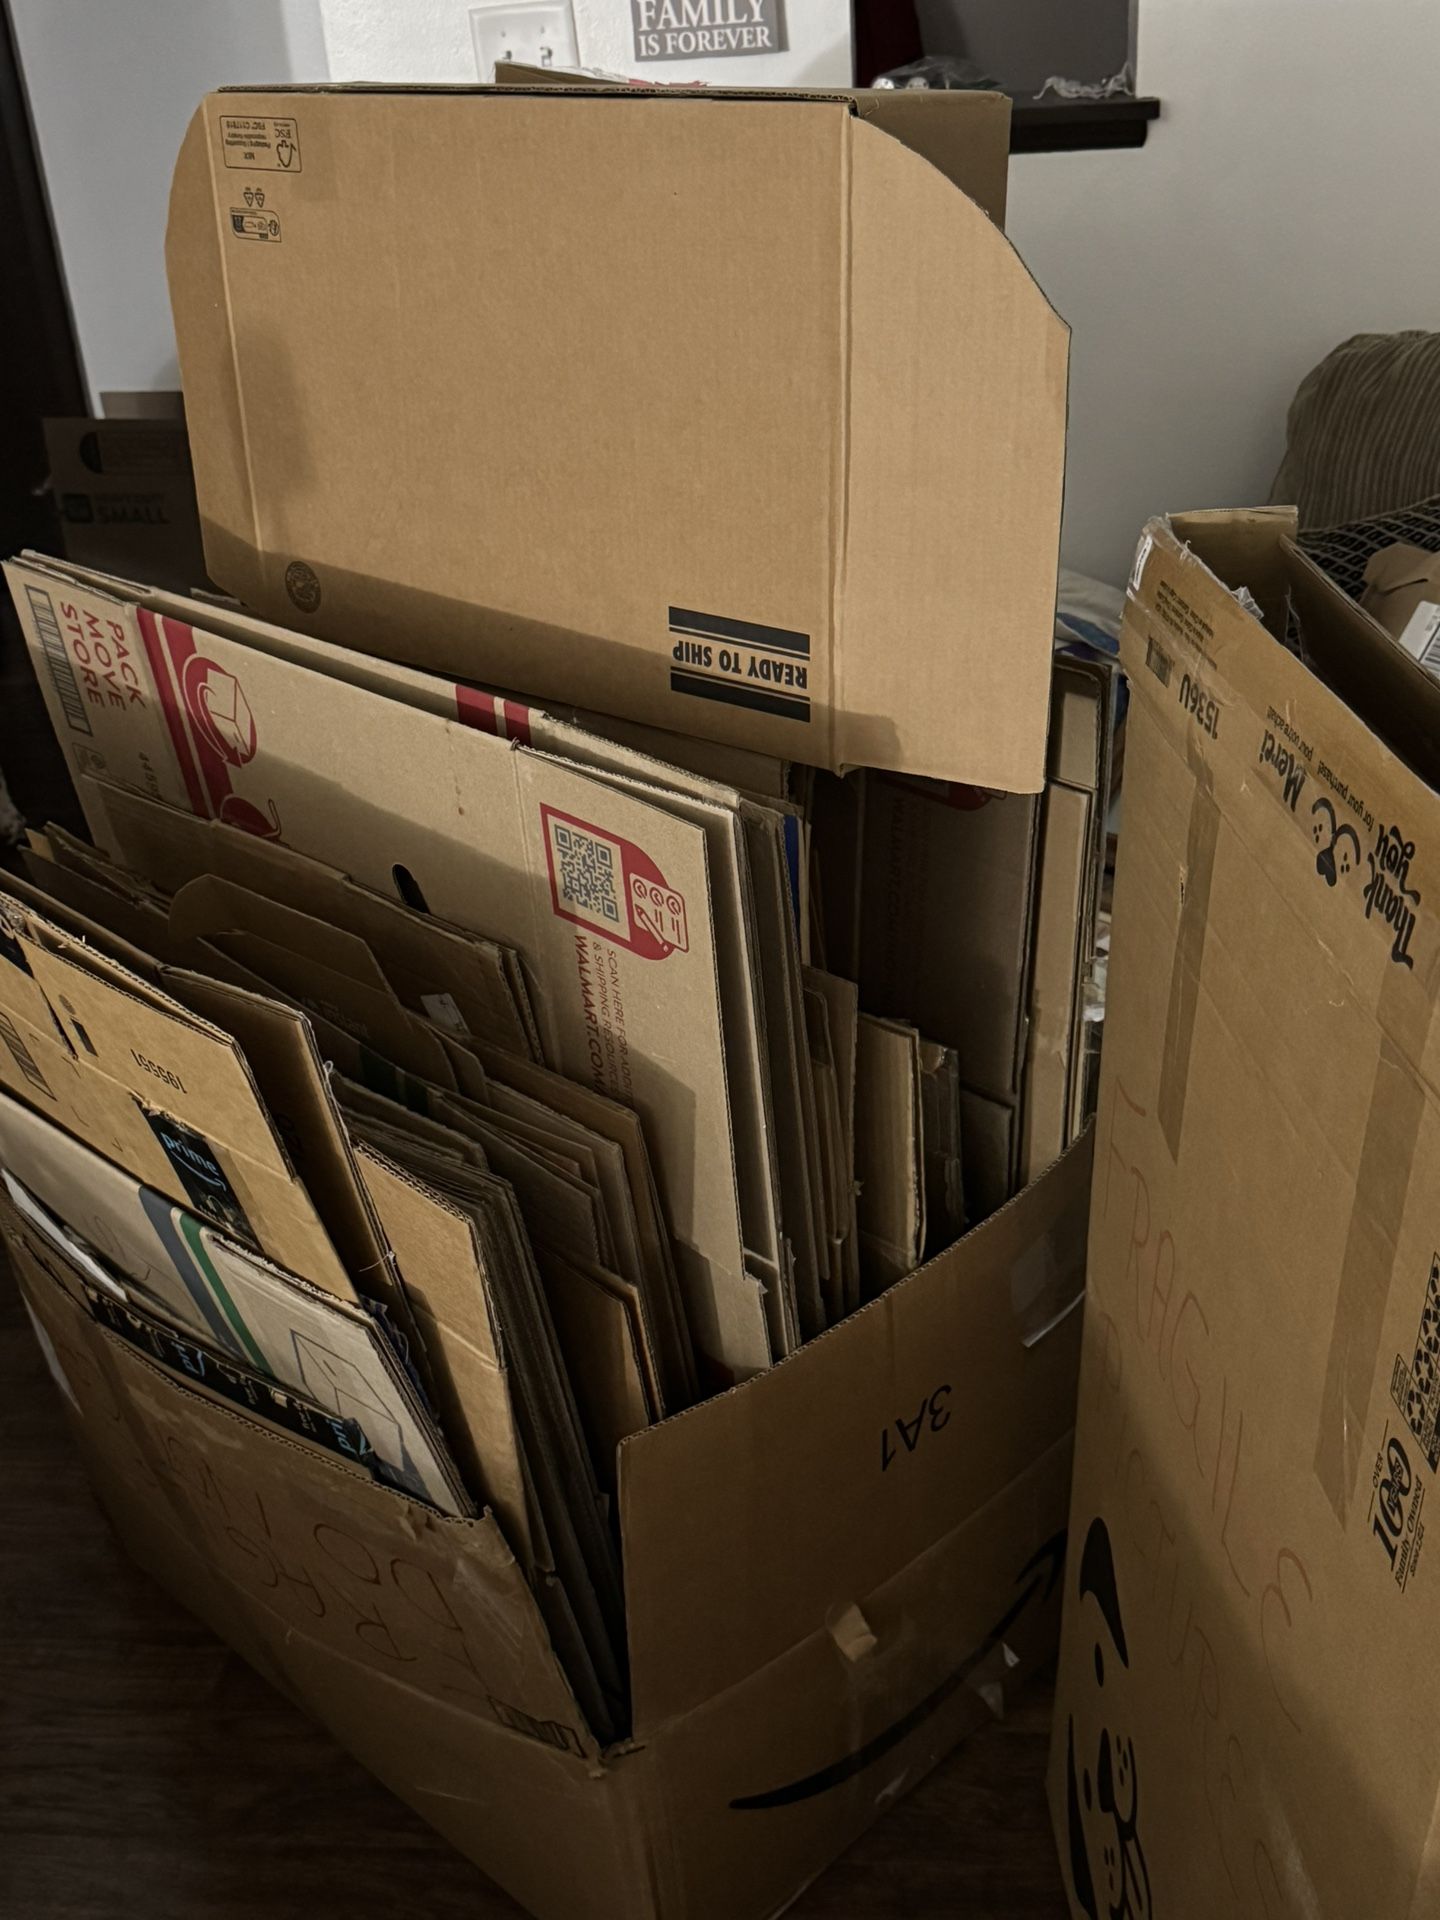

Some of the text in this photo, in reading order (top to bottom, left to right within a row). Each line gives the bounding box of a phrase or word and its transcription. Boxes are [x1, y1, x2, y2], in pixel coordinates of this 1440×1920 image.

[638, 0, 764, 31] FAMILY
[638, 26, 772, 56] IS FOREVER
[60, 602, 105, 708] STORE
[83, 610, 126, 711] MOVE
[106, 619, 146, 709] PACK
[673, 640, 807, 690] READY TO SHIP
[1178, 674, 1219, 740] 1536U
[1259, 729, 1308, 813] Merci
[1298, 741, 1314, 761] pour
[1347, 796, 1366, 818] your
[1362, 814, 1375, 832] for
[1375, 823, 1421, 906] you
[1363, 852, 1416, 970] Thank
[592, 941, 602, 950] &
[607, 948, 619, 988] SCAN
[594, 954, 611, 1017] SHIPPING
[612, 988, 624, 1026] HERE
[617, 1026, 628, 1056] FOR
[130, 1049, 189, 1094] 195551
[159, 1131, 220, 1174] prime
[879, 1383, 953, 1472] 3A1
[1372, 1452, 1384, 1488] OVER
[1373, 1437, 1412, 1572] 100
[1395, 1534, 1409, 1586] Family
[1406, 1474, 1422, 1534] Owned
